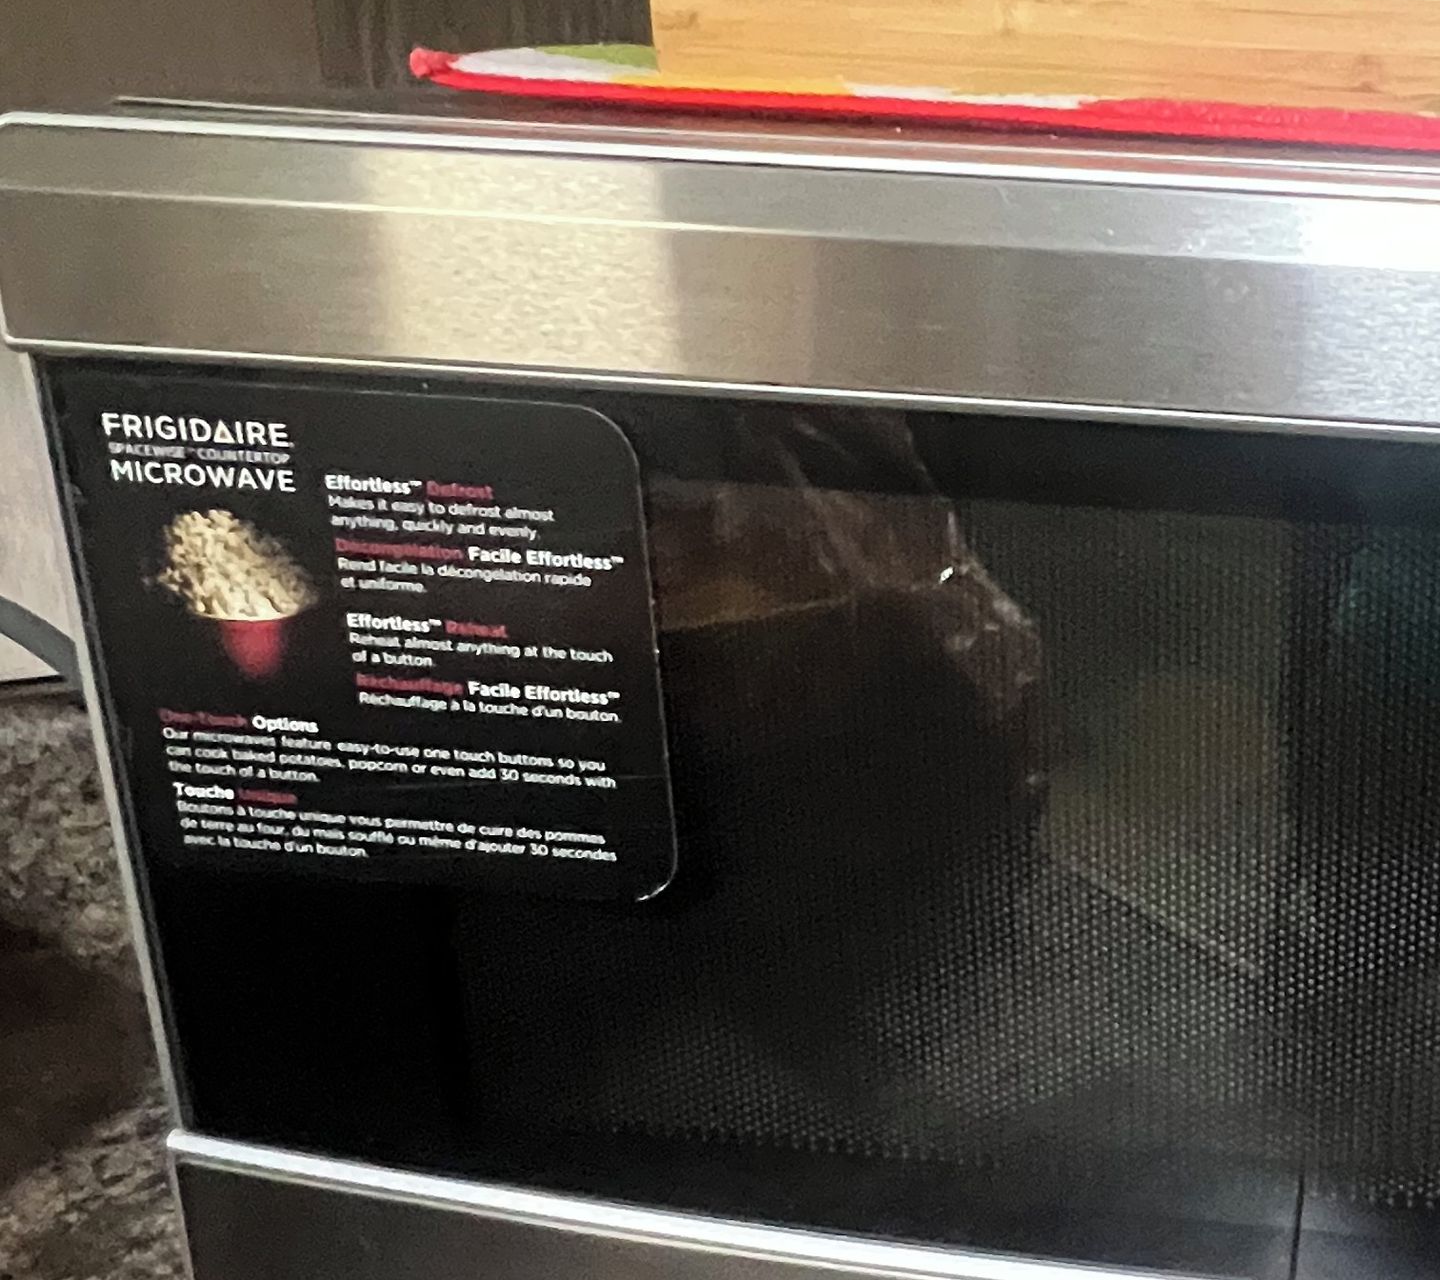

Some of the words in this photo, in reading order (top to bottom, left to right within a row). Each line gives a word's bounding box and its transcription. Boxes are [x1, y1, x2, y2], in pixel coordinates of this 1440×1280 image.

[197, 449, 290, 464] COUNTERTOP
[110, 460, 296, 492] MICROWAVE
[329, 495, 374, 509] Makes
[378, 499, 388, 511] it
[391, 501, 424, 516] easy
[428, 502, 445, 514] to
[449, 503, 501, 518] defrost
[505, 507, 554, 522] almost
[402, 519, 453, 535] quickly
[457, 522, 485, 535] and
[467, 546, 521, 564] Facile
[337, 557, 376, 572] Rend
[380, 560, 417, 575] facile
[421, 562, 434, 576] la
[545, 572, 592, 587] rapide
[340, 577, 355, 589] et
[349, 633, 400, 648] Reheat
[404, 638, 454, 651] almost
[457, 641, 520, 658] anything
[524, 646, 538, 658] at
[542, 646, 567, 659] the
[570, 648, 613, 662] touch
[352, 650, 367, 662] of
[371, 653, 380, 663] a
[468, 681, 521, 698] Facile
[463, 700, 475, 712] la
[478, 701, 529, 716] touche
[252, 715, 319, 733] Options
[163, 727, 188, 739] Our
[193, 732, 275, 746] microwaves
[281, 735, 331, 750] feature
[423, 748, 450, 759] one
[454, 749, 495, 762] touch
[498, 751, 553, 767] buttons
[557, 758, 575, 769] so
[578, 760, 606, 772] you
[166, 746, 191, 756] can
[195, 748, 229, 759] cook
[232, 750, 275, 763] baked
[348, 759, 408, 772] popcorn
[412, 763, 426, 773] or
[430, 766, 465, 777] even
[468, 767, 496, 779] add
[501, 769, 519, 781] 30
[523, 771, 582, 786] seconds
[584, 776, 617, 788] with
[168, 761, 191, 772] the
[195, 763, 236, 776] touch
[239, 766, 253, 777] of
[257, 769, 266, 778] a
[173, 782, 234, 799] Touche
[249, 806, 296, 820] touche
[299, 811, 346, 824] unique
[348, 815, 382, 826] vous
[385, 818, 454, 832] permettre
[457, 822, 475, 834] de
[479, 825, 513, 837] cuire
[516, 827, 542, 839] des
[545, 831, 606, 844] pommes
[180, 818, 197, 828] de
[201, 820, 234, 832] terre
[237, 824, 254, 833] au
[292, 826, 310, 837] du
[398, 836, 416, 845] ou
[530, 843, 548, 856] 30
[551, 847, 617, 861] secondes
[184, 834, 216, 845] avec
[218, 835, 231, 847] la
[233, 838, 281, 851] touche
